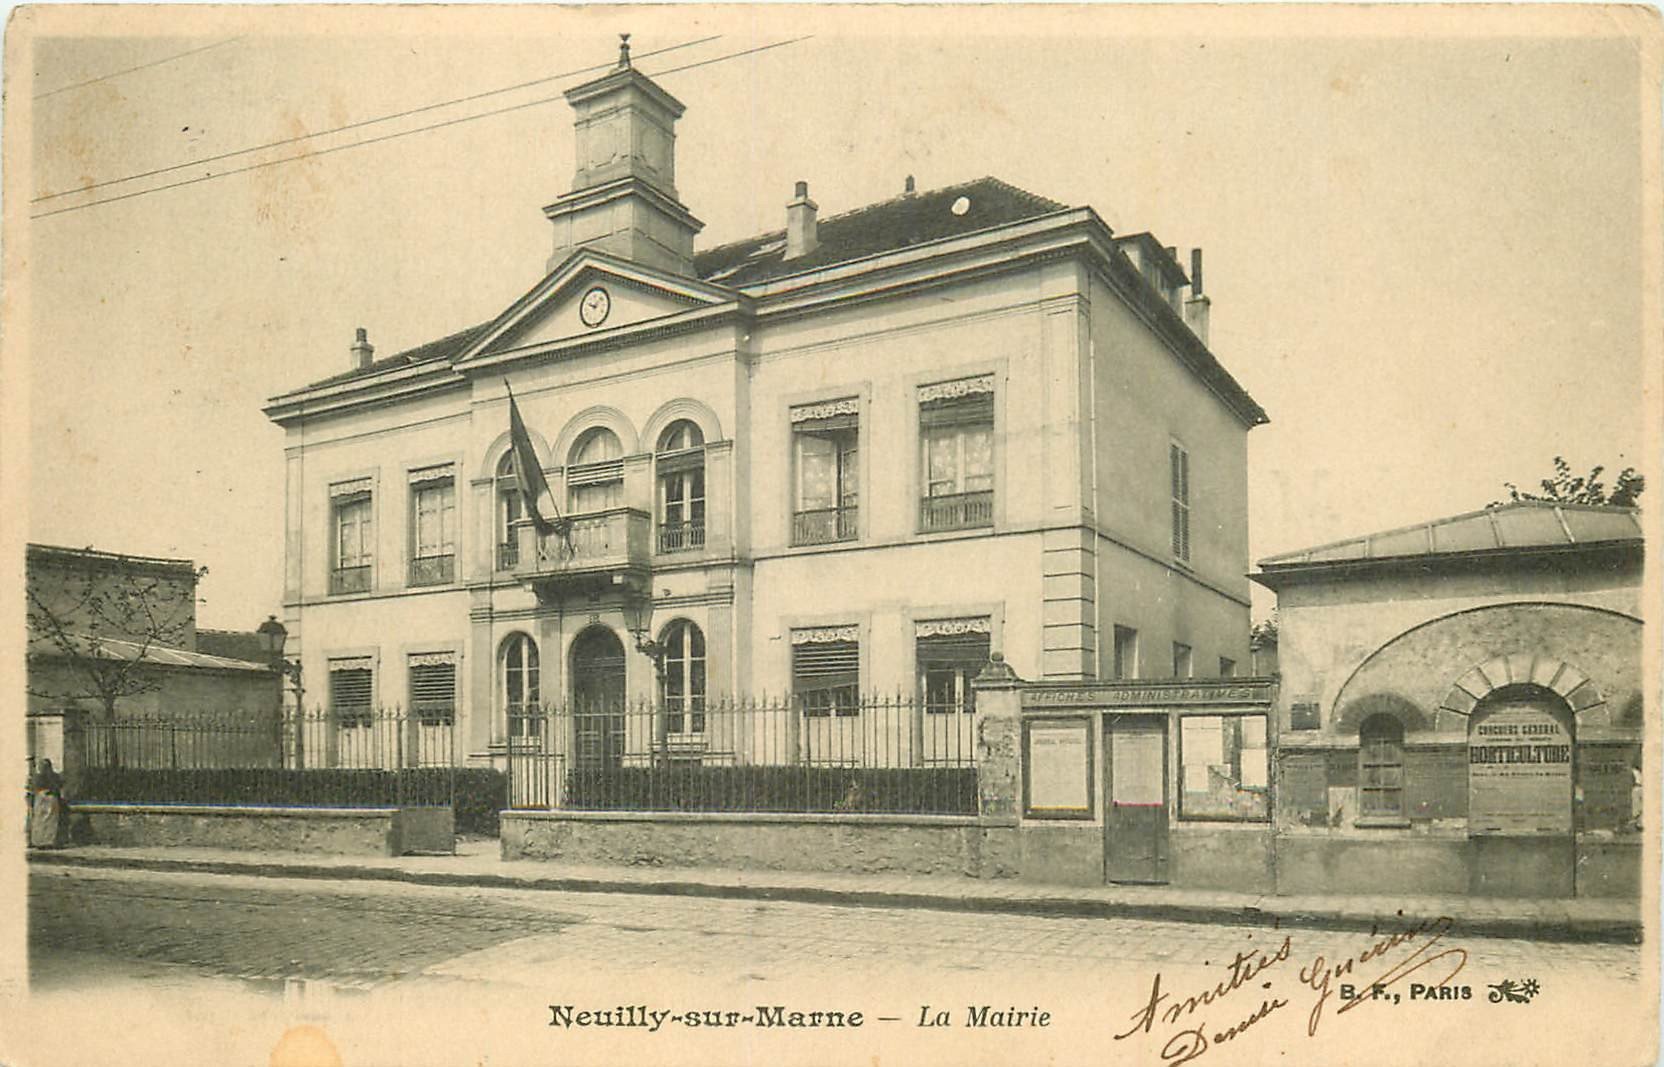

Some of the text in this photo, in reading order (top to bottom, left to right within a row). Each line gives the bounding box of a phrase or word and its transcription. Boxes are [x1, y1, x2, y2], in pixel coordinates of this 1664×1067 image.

[1031, 688, 1251, 702] AFFICHES ADMINISTRATIVES
[1470, 744, 1570, 764] HORTICULTURE
[1113, 917, 1291, 1040] Amitiés
[1161, 982, 1288, 1067] Denise
